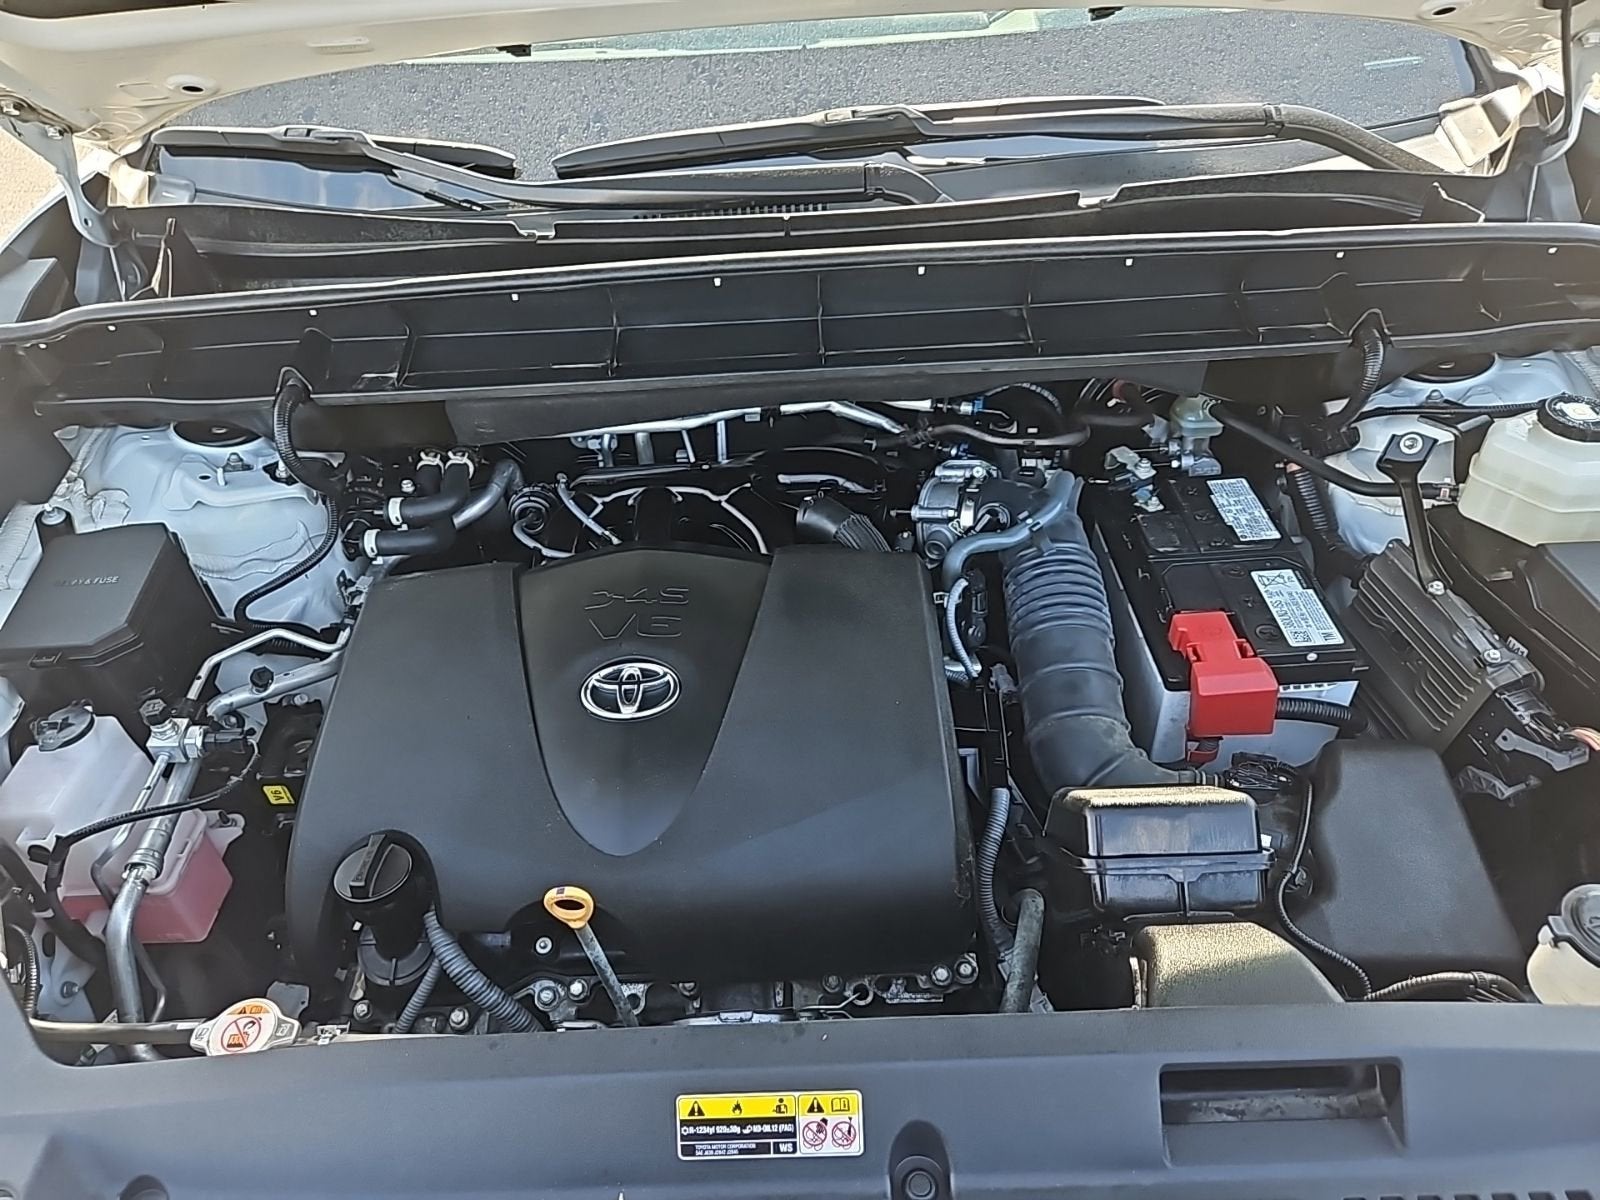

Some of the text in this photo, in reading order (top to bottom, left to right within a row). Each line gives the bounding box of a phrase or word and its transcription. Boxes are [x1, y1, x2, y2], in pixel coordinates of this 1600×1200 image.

[588, 613, 682, 639] V6
[271, 790, 284, 800] V6
[779, 1143, 793, 1152] WS
